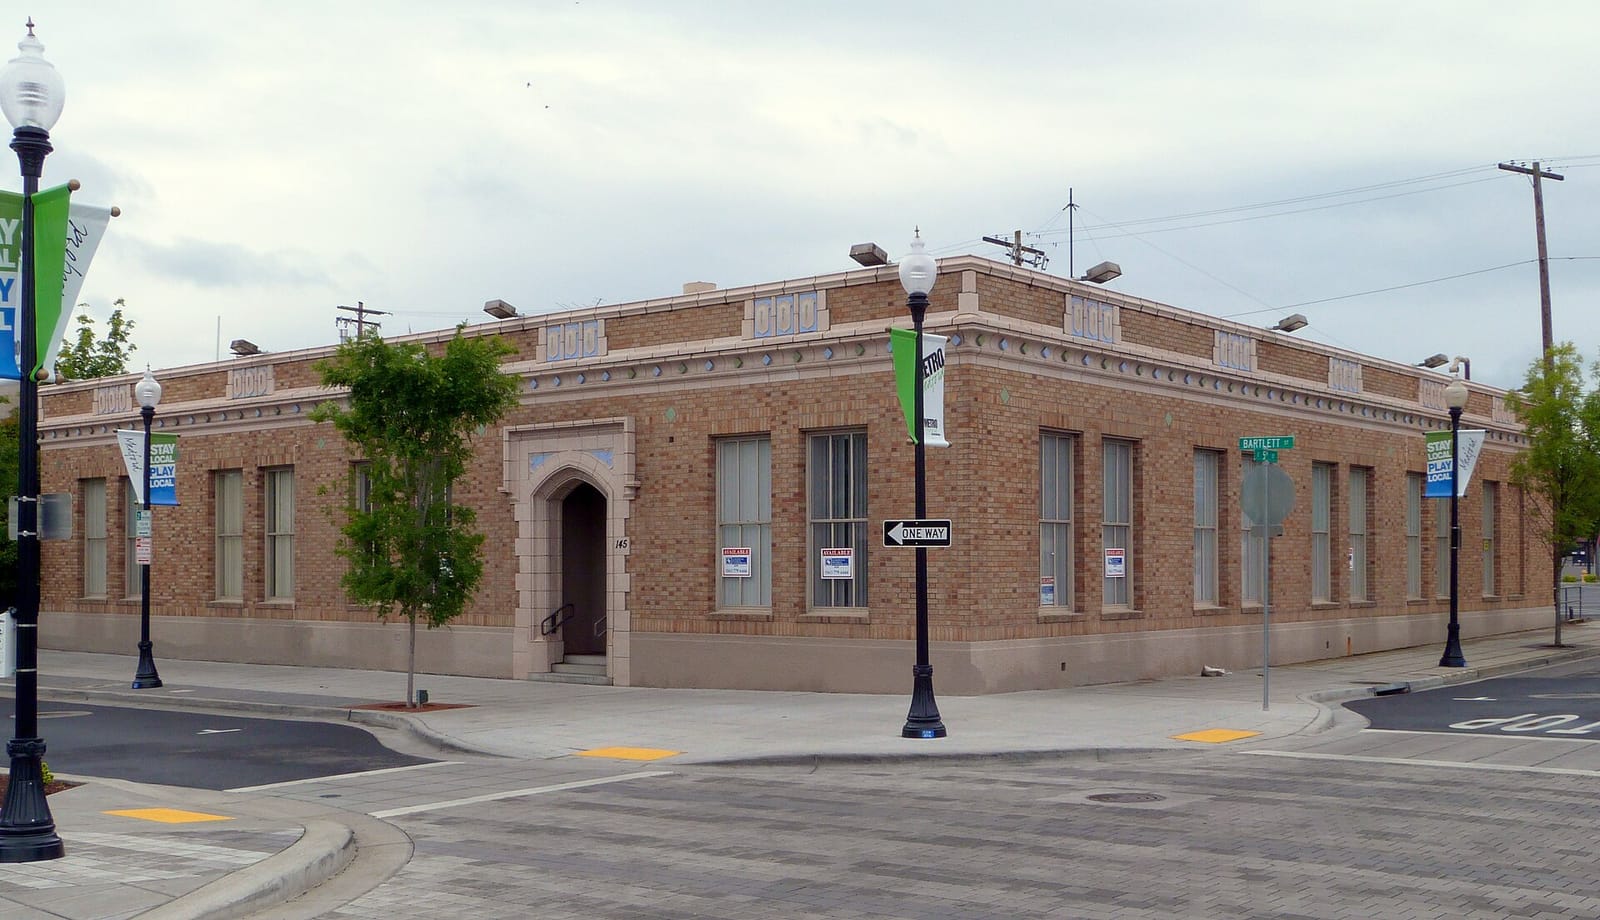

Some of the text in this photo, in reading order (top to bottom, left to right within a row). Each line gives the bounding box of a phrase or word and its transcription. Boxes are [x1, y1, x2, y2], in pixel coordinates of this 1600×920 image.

[62, 219, 88, 296] ford
[923, 348, 944, 379] ETRO
[1243, 438, 1280, 448] BARTLETT
[1427, 440, 1450, 452] STAY
[150, 443, 175, 455] STAY
[150, 455, 175, 464] LOCAL
[1428, 451, 1452, 460] LOCAL
[150, 466, 174, 477] PLAY
[1429, 461, 1451, 472] PLAY
[1428, 473, 1452, 482] LOCAL
[150, 479, 174, 488] LOCAL
[902, 528, 944, 538] ONE WAY
[615, 539, 628, 549] 145
[1449, 713, 1600, 734] TOP
